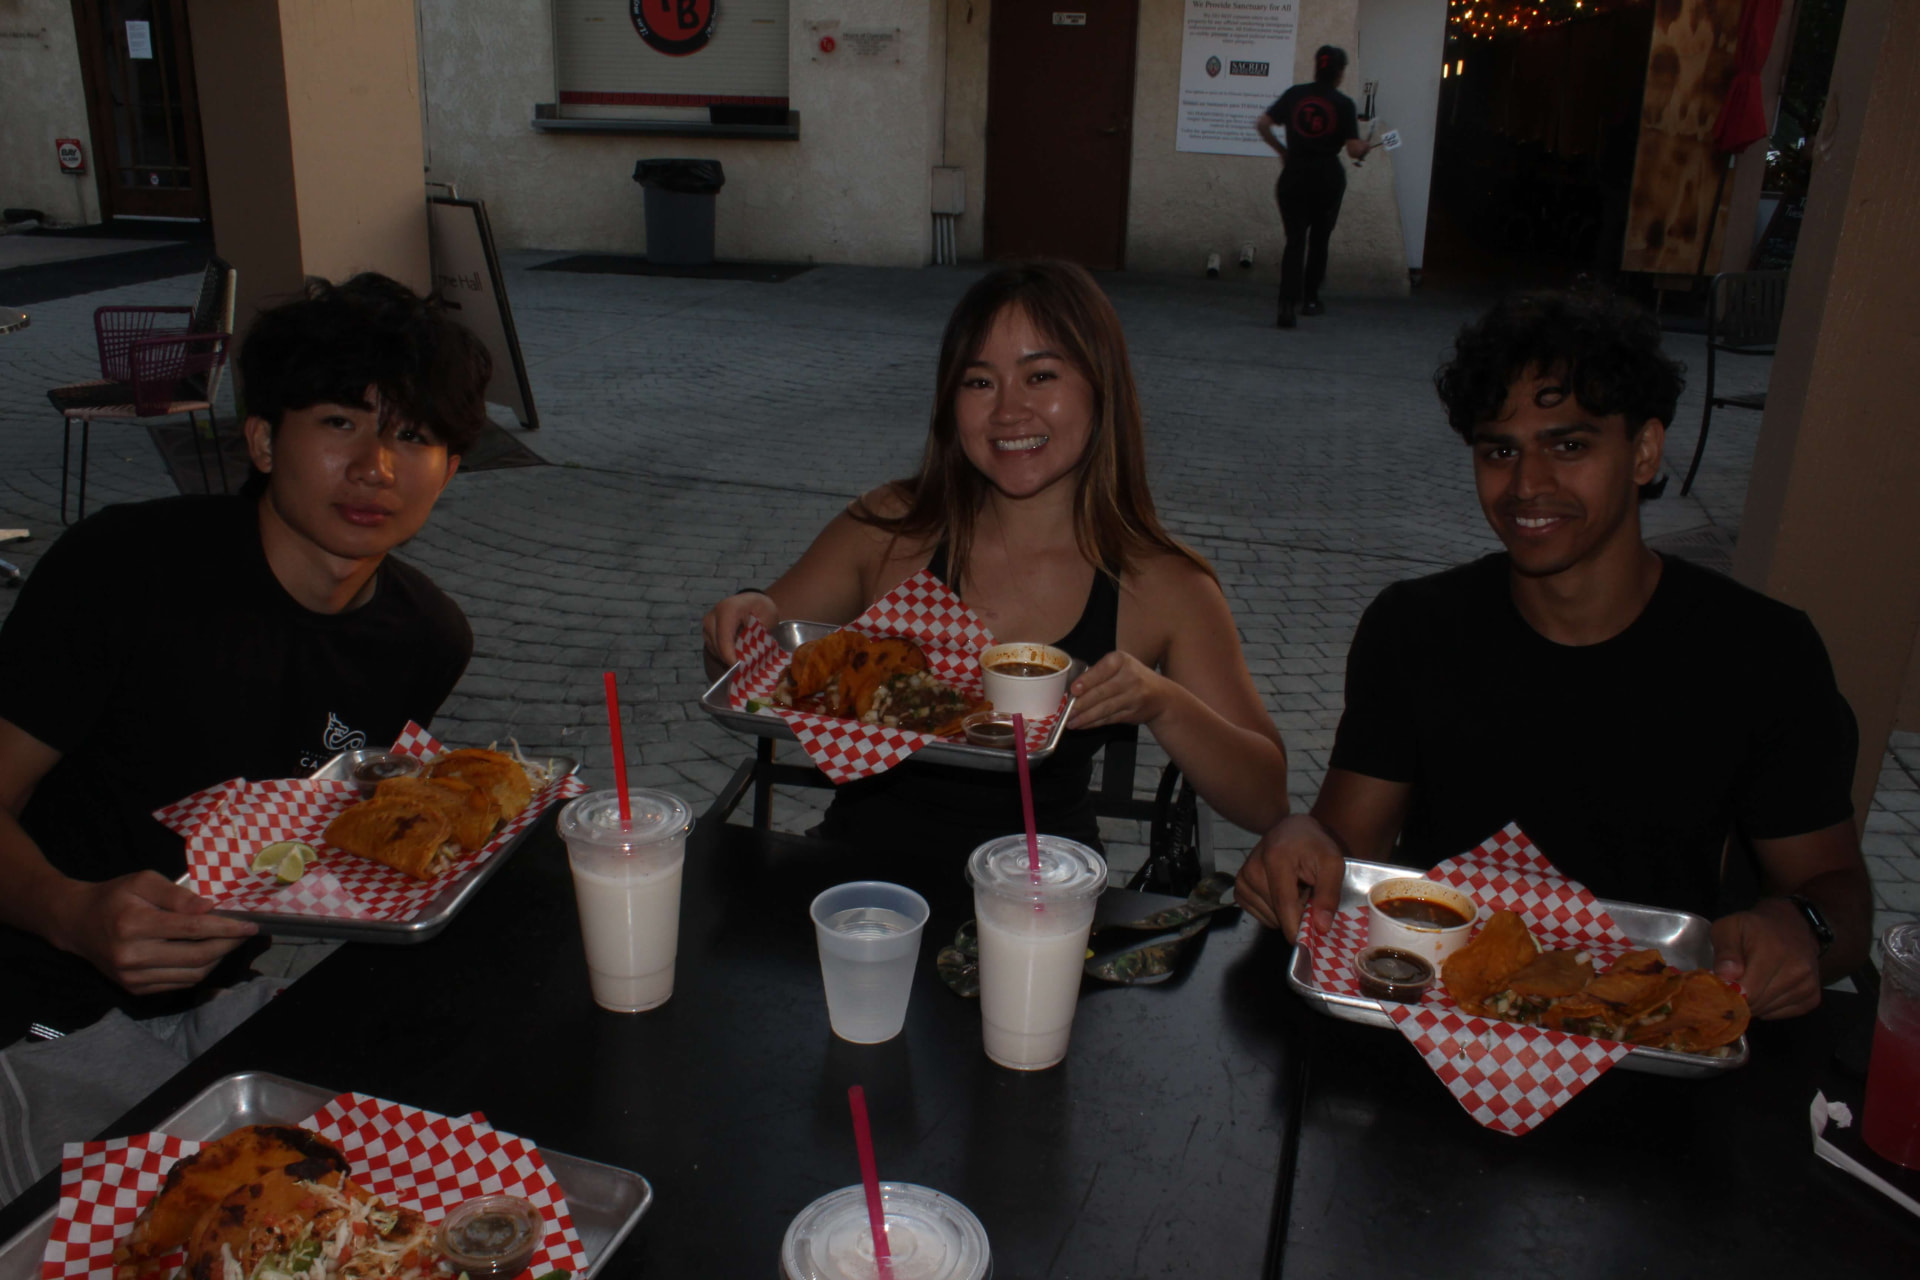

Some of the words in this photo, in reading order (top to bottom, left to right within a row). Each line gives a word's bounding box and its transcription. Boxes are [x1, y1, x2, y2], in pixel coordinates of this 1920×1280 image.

[1205, 1, 1231, 9] Provide
[1233, 2, 1266, 11] Sanctuary
[61, 149, 77, 157] BAY
